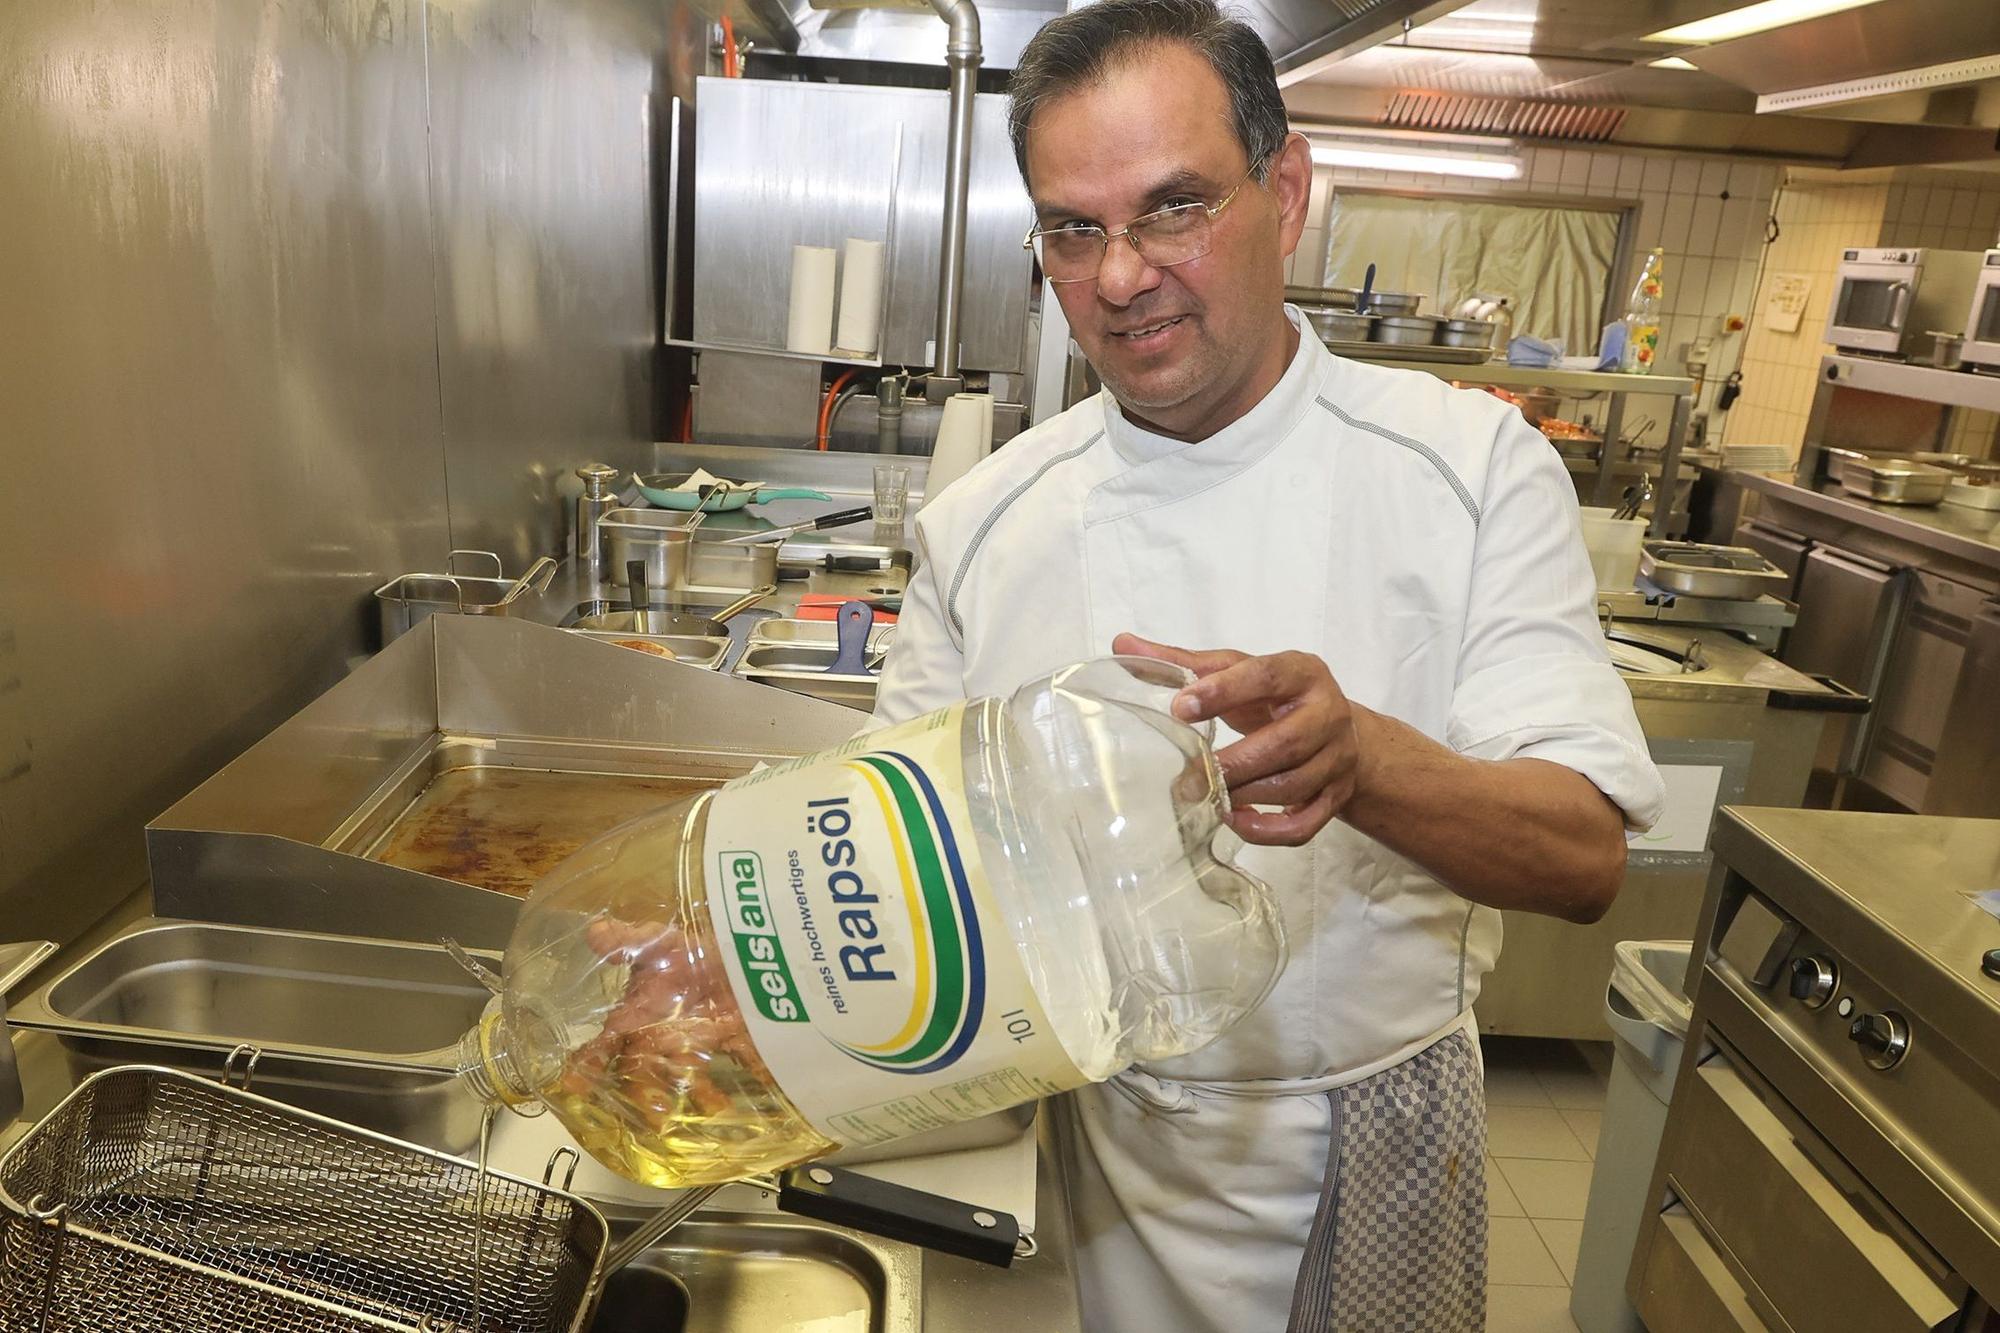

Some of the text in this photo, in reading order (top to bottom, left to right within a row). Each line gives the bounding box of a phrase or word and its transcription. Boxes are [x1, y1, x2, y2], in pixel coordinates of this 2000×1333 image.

[735, 857, 798, 1022] selsana
[787, 849, 848, 1014] reines hochwertiges
[807, 796, 897, 982] Rapsöl
